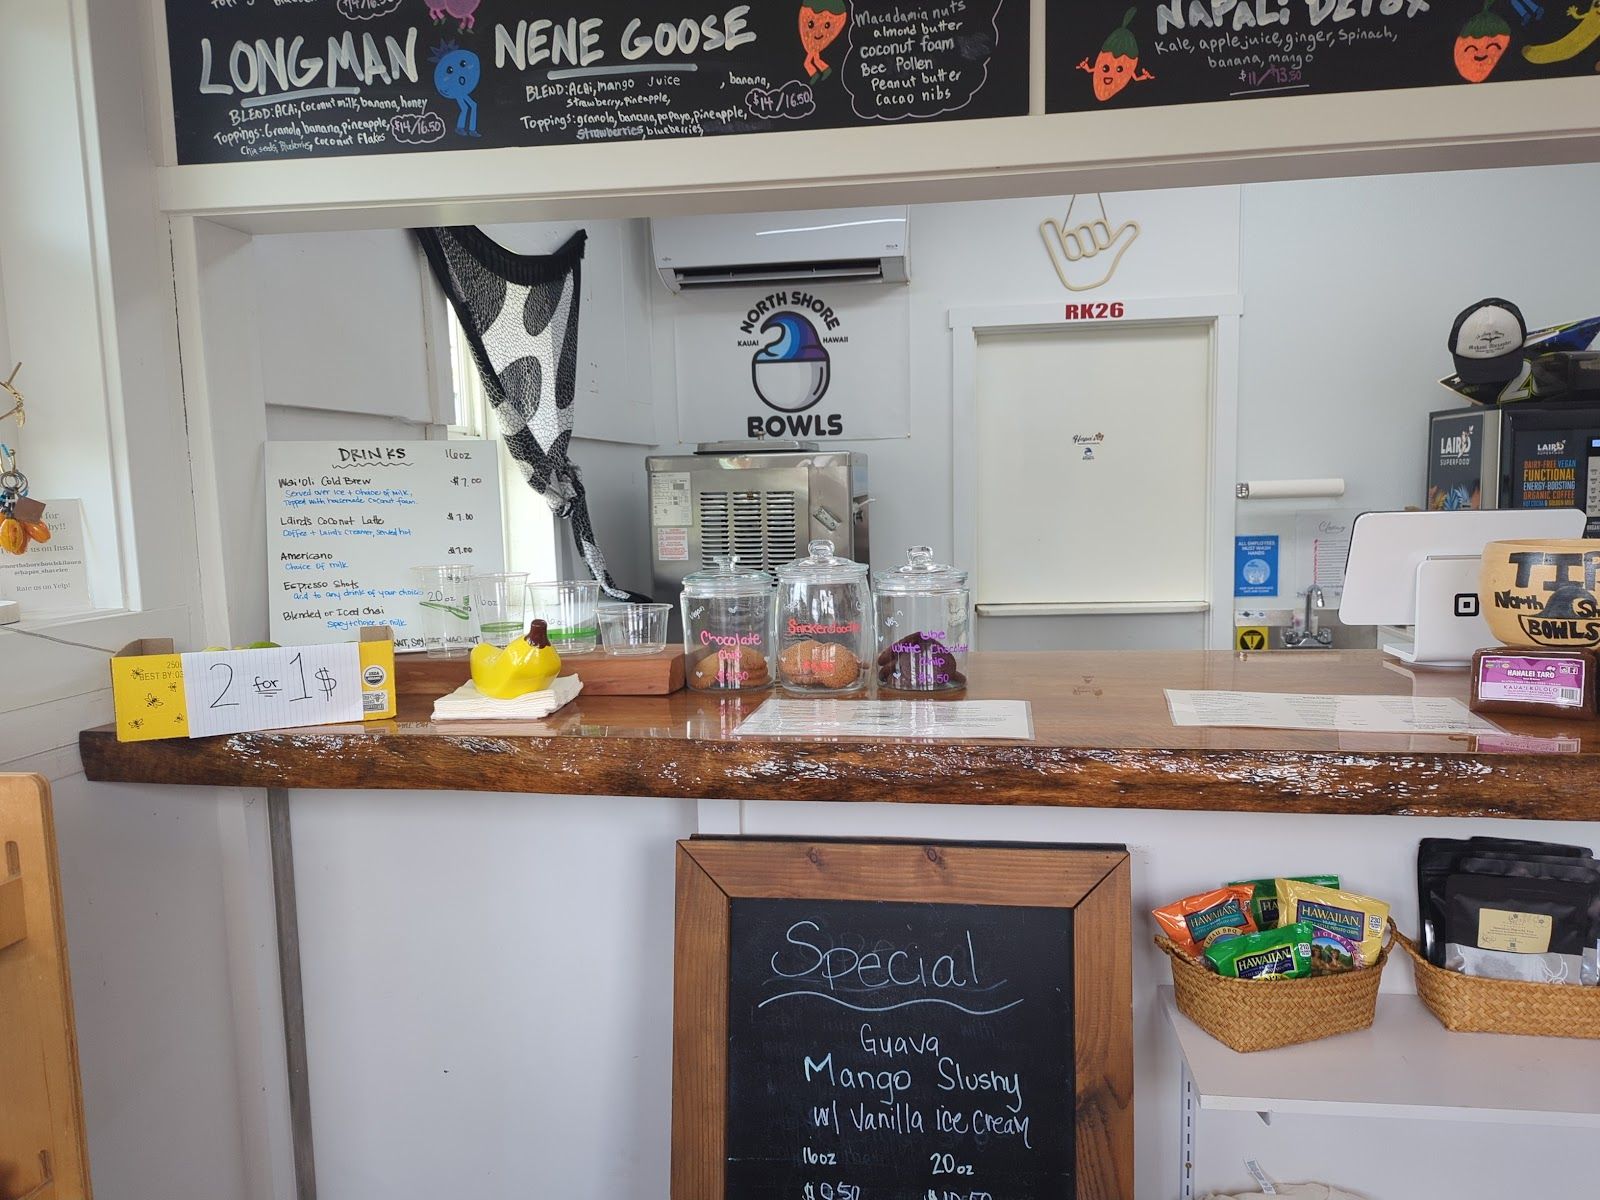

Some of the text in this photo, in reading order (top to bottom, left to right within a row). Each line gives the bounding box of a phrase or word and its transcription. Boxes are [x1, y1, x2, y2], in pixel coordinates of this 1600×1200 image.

[855, 1, 967, 28] Macadamia nuts
[495, 5, 758, 71] NENE GOOSE
[873, 20, 964, 39] almond butter
[860, 36, 955, 59] coconut foam
[1155, 38, 1195, 55] Kale,
[1285, 29, 1336, 52] ginger,
[861, 57, 934, 78] Bee Pollen
[1208, 53, 1314, 70] banana, mango
[596, 78, 635, 92] mango
[728, 71, 771, 90] banana,
[871, 69, 963, 93] Peanut butter
[400, 94, 428, 115] honey
[875, 87, 952, 107] Cacao nibs
[739, 290, 841, 335] NORTH SHORE
[1065, 302, 1125, 320] RK26
[737, 339, 760, 348] KAUAI
[822, 336, 850, 345] HAWAII
[747, 413, 844, 438] BOWLS
[337, 447, 407, 463] DRINKS
[1440, 436, 1472, 454] LAIRD
[1537, 442, 1565, 452] LAIRD
[1439, 458, 1471, 466] SUPERFOOD
[1557, 459, 1577, 468] VEGAN
[320, 475, 342, 486] Cold
[344, 476, 372, 486] Brew
[1523, 468, 1576, 481] FUNCTIONAL
[1523, 481, 1576, 491] ENERGY-BOOSTING
[1523, 490, 1575, 500] ORGANIC COFFEE
[280, 552, 333, 560] Americano
[700, 629, 763, 647] Chocolate
[1527, 619, 1600, 641] BOWLS
[139, 672, 160, 681] BEST
[209, 663, 282, 709] 2 for
[1190, 904, 1238, 928] HAWAIIAN
[1302, 906, 1359, 926] HAWAIIAN
[771, 921, 979, 991] Special
[1238, 949, 1290, 971] HAWAIIAN
[860, 1023, 940, 1057] Guava
[804, 1053, 1023, 1113] Mango Slushy
[850, 1102, 924, 1135] Vanilla
